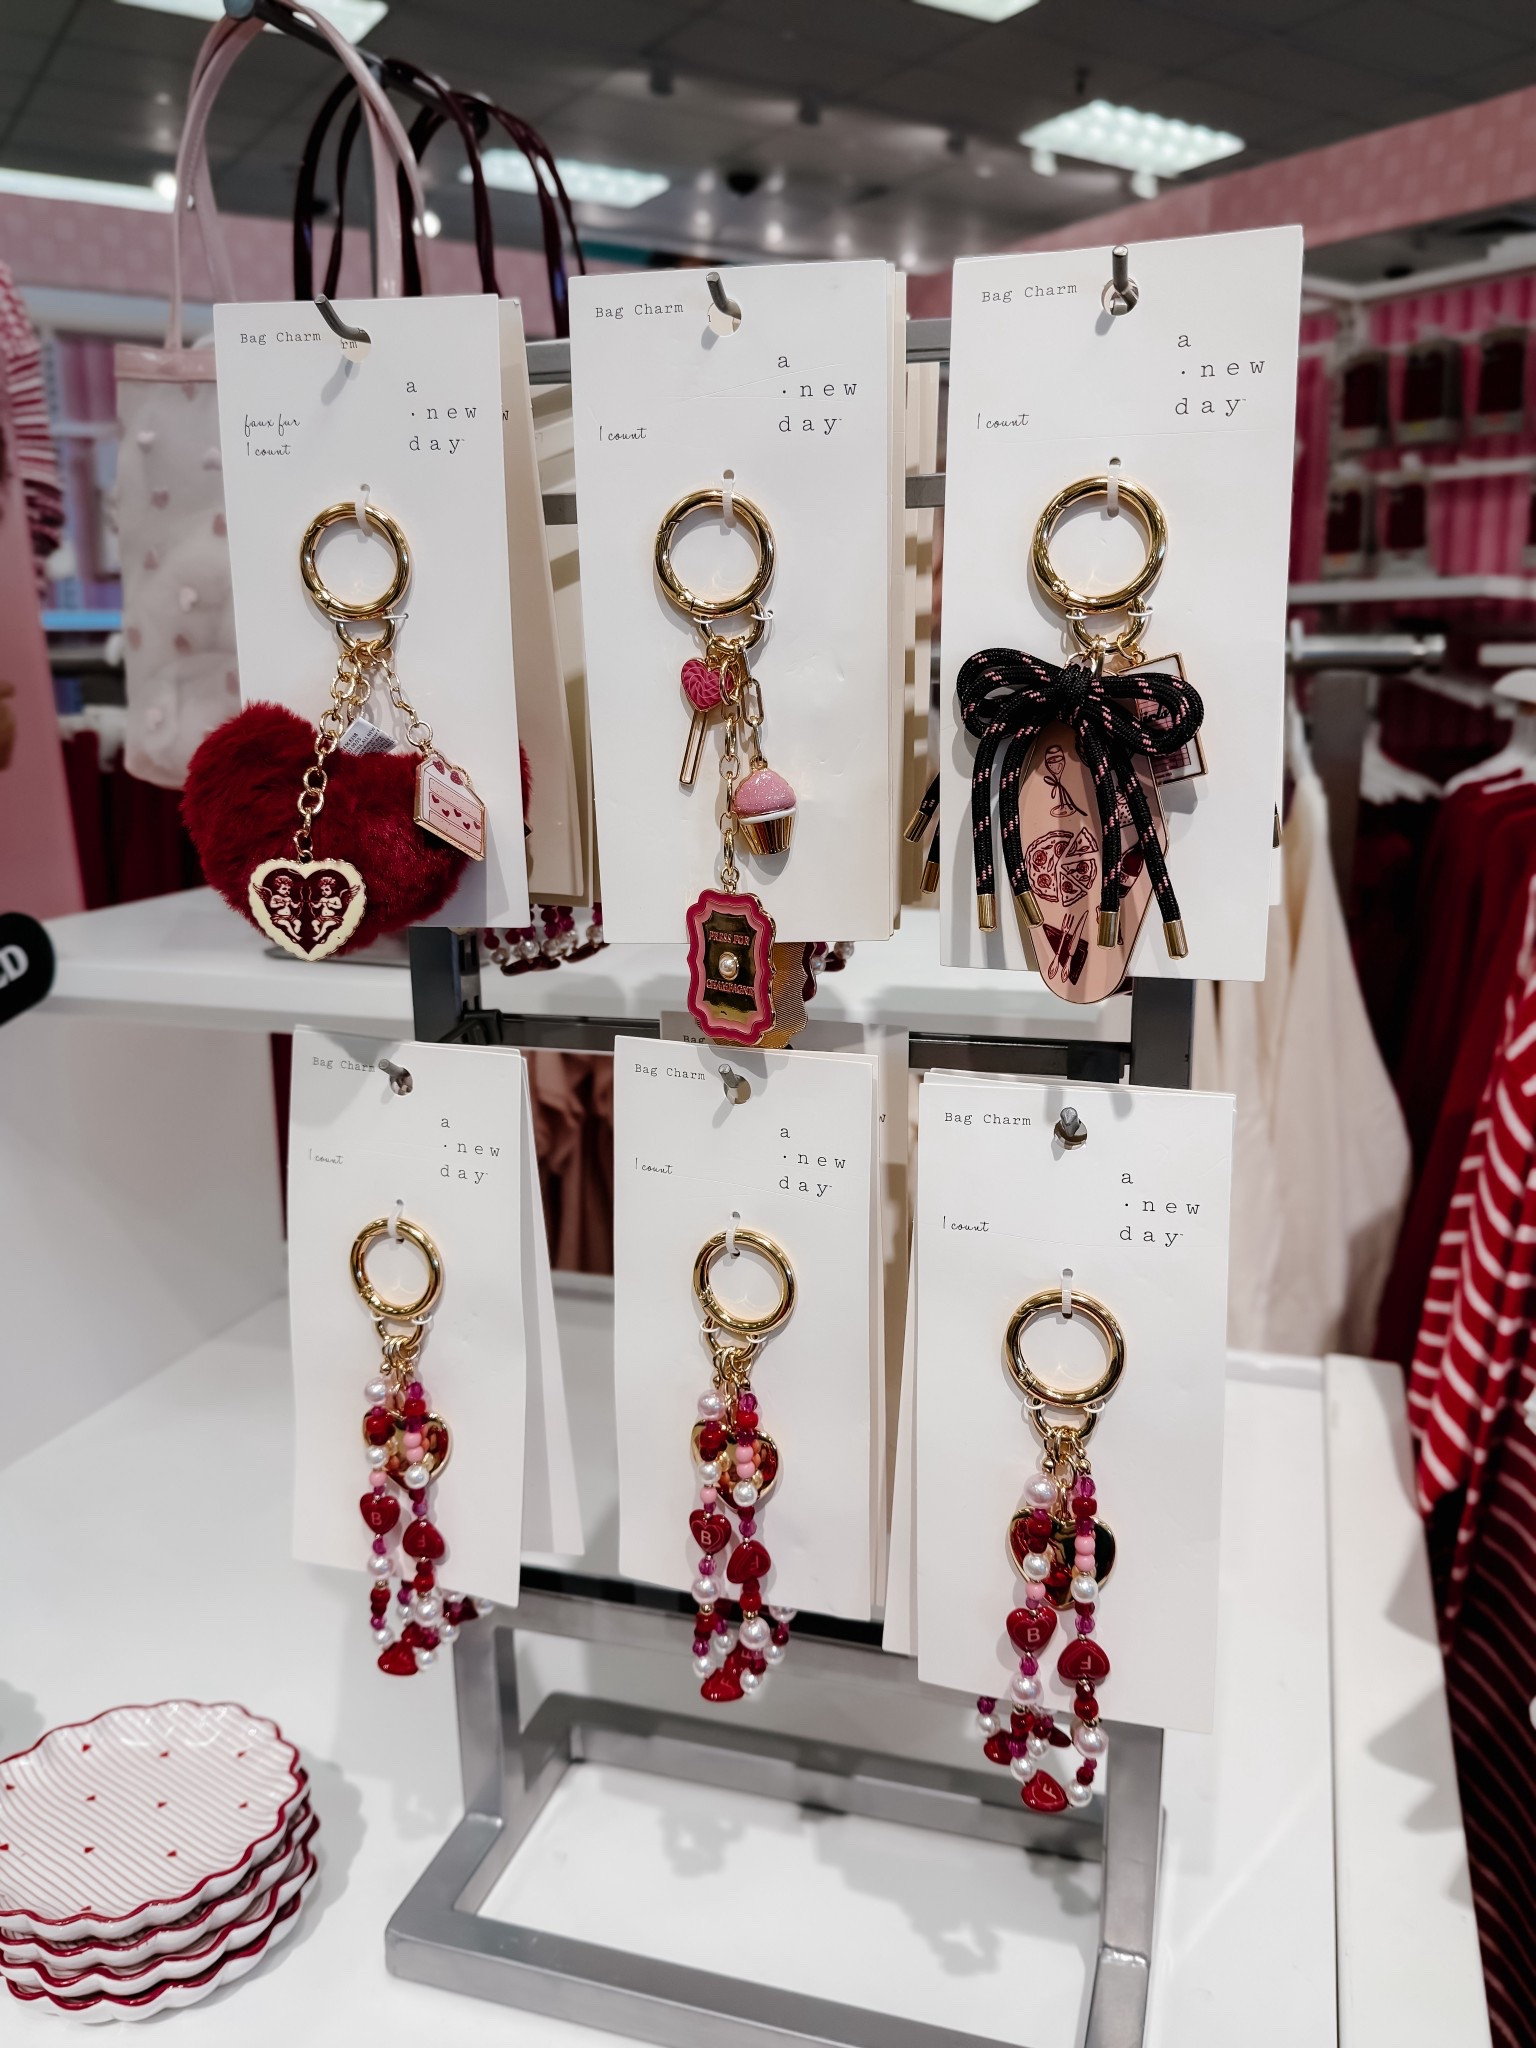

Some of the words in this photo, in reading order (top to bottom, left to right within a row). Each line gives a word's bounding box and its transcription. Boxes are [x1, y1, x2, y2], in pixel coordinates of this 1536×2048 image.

[981, 290, 1013, 304] Bag
[1024, 284, 1078, 298] Charm
[594, 306, 624, 320] Bag
[634, 303, 684, 316] Charm
[239, 333, 267, 346] Bag
[276, 331, 322, 343] Charm
[1177, 334, 1192, 348] a
[777, 355, 791, 369] a
[406, 381, 418, 394] a
[244, 413, 275, 438] faux
[277, 412, 301, 437] fur
[985, 412, 1030, 429] count
[607, 426, 648, 442] count
[254, 443, 292, 457] count
[708, 930, 732, 944] PRESS
[733, 934, 750, 947] FOR
[706, 978, 756, 997] CHAMPAGNE
[312, 1056, 334, 1070] Bag
[339, 1058, 376, 1073] Charm
[634, 1063, 658, 1078] Bag
[666, 1067, 706, 1081] Charm
[440, 1117, 451, 1129] a
[944, 1112, 973, 1126] Bag
[983, 1113, 1032, 1126] Charm
[779, 1127, 791, 1139] a
[313, 1154, 344, 1165] count
[641, 1164, 674, 1175] count
[1120, 1172, 1134, 1185] a
[950, 1220, 990, 1233] count
[370, 1511, 383, 1526] B
[700, 1530, 712, 1545] B
[1026, 1627, 1041, 1643] B
